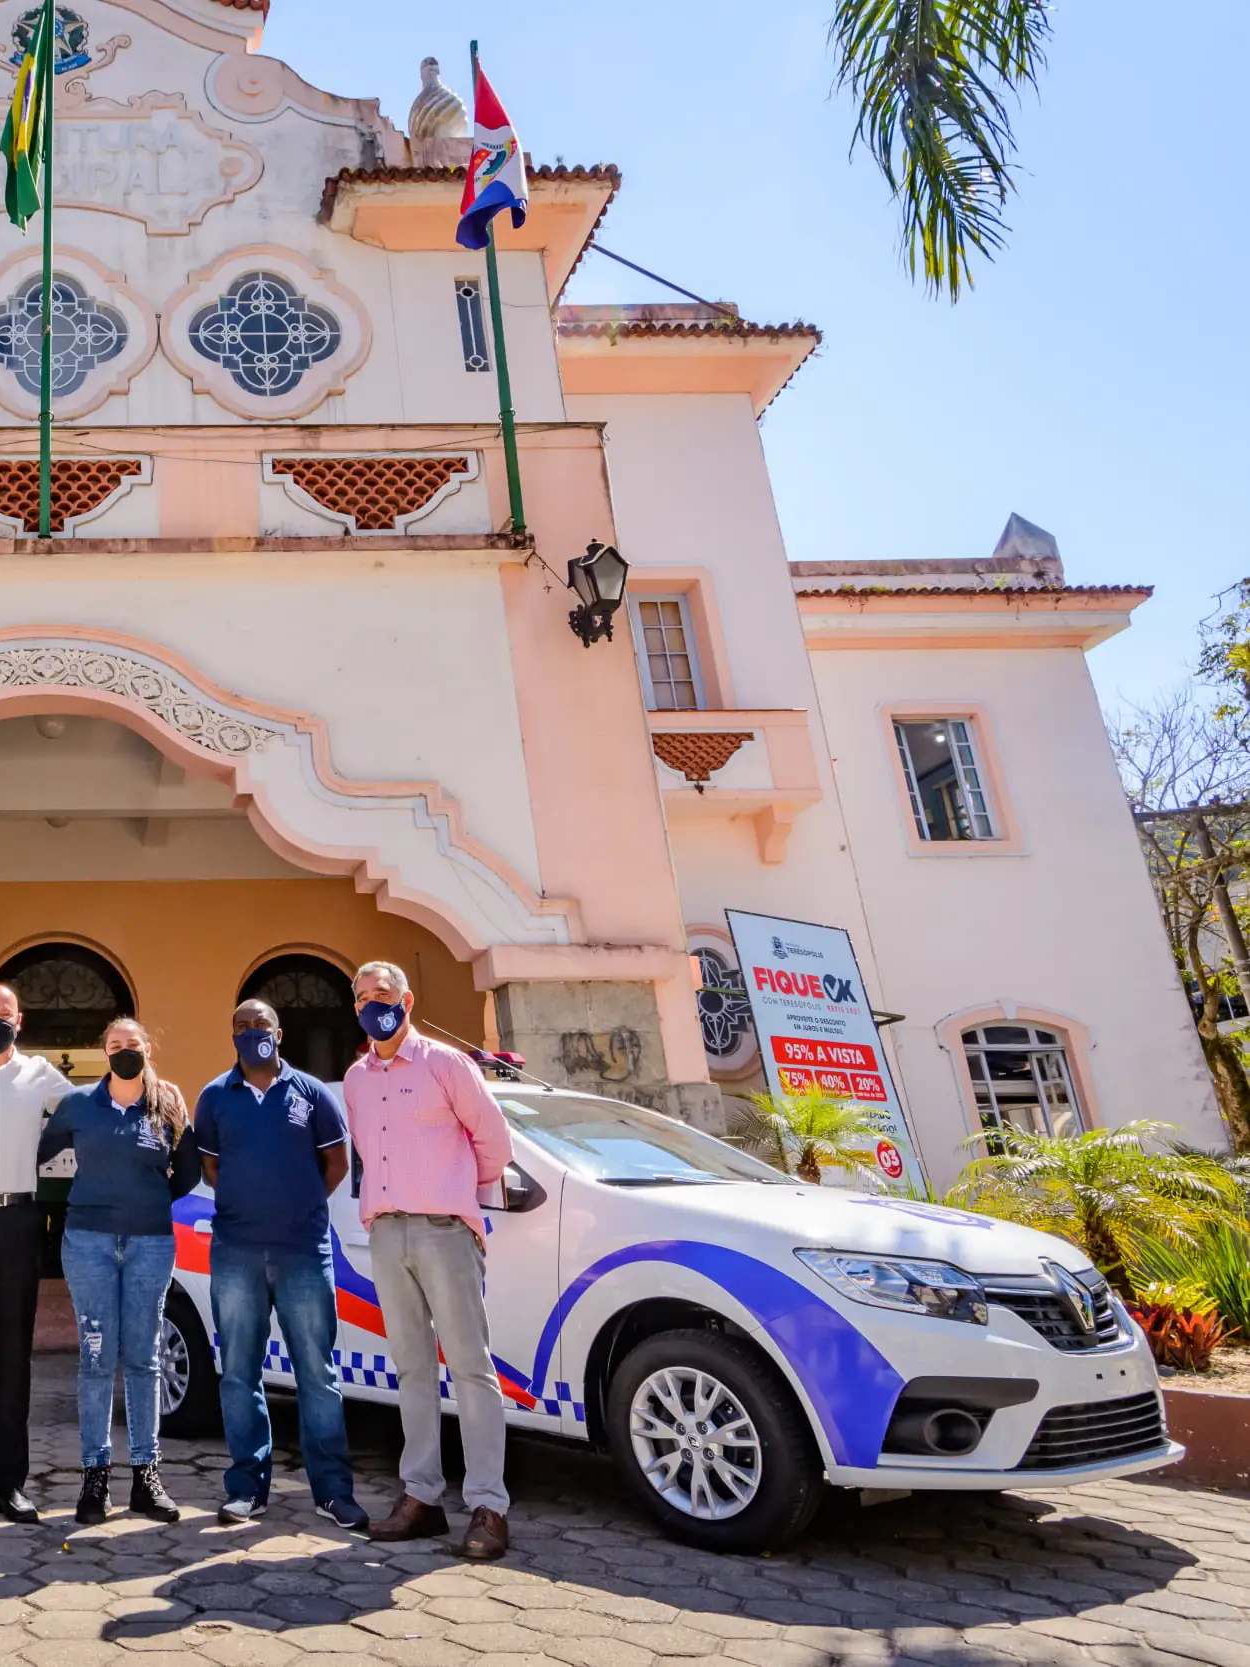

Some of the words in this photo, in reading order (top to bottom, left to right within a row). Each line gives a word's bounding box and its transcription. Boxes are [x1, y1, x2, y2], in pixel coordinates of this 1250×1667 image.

[752, 966, 826, 999] FIQUE
[784, 1042, 814, 1061] 95%
[827, 1046, 867, 1065] VISTA
[784, 1070, 810, 1086] 75%
[820, 1074, 846, 1089] 40%
[856, 1076, 881, 1092] 20%
[879, 1149, 900, 1168] 03
